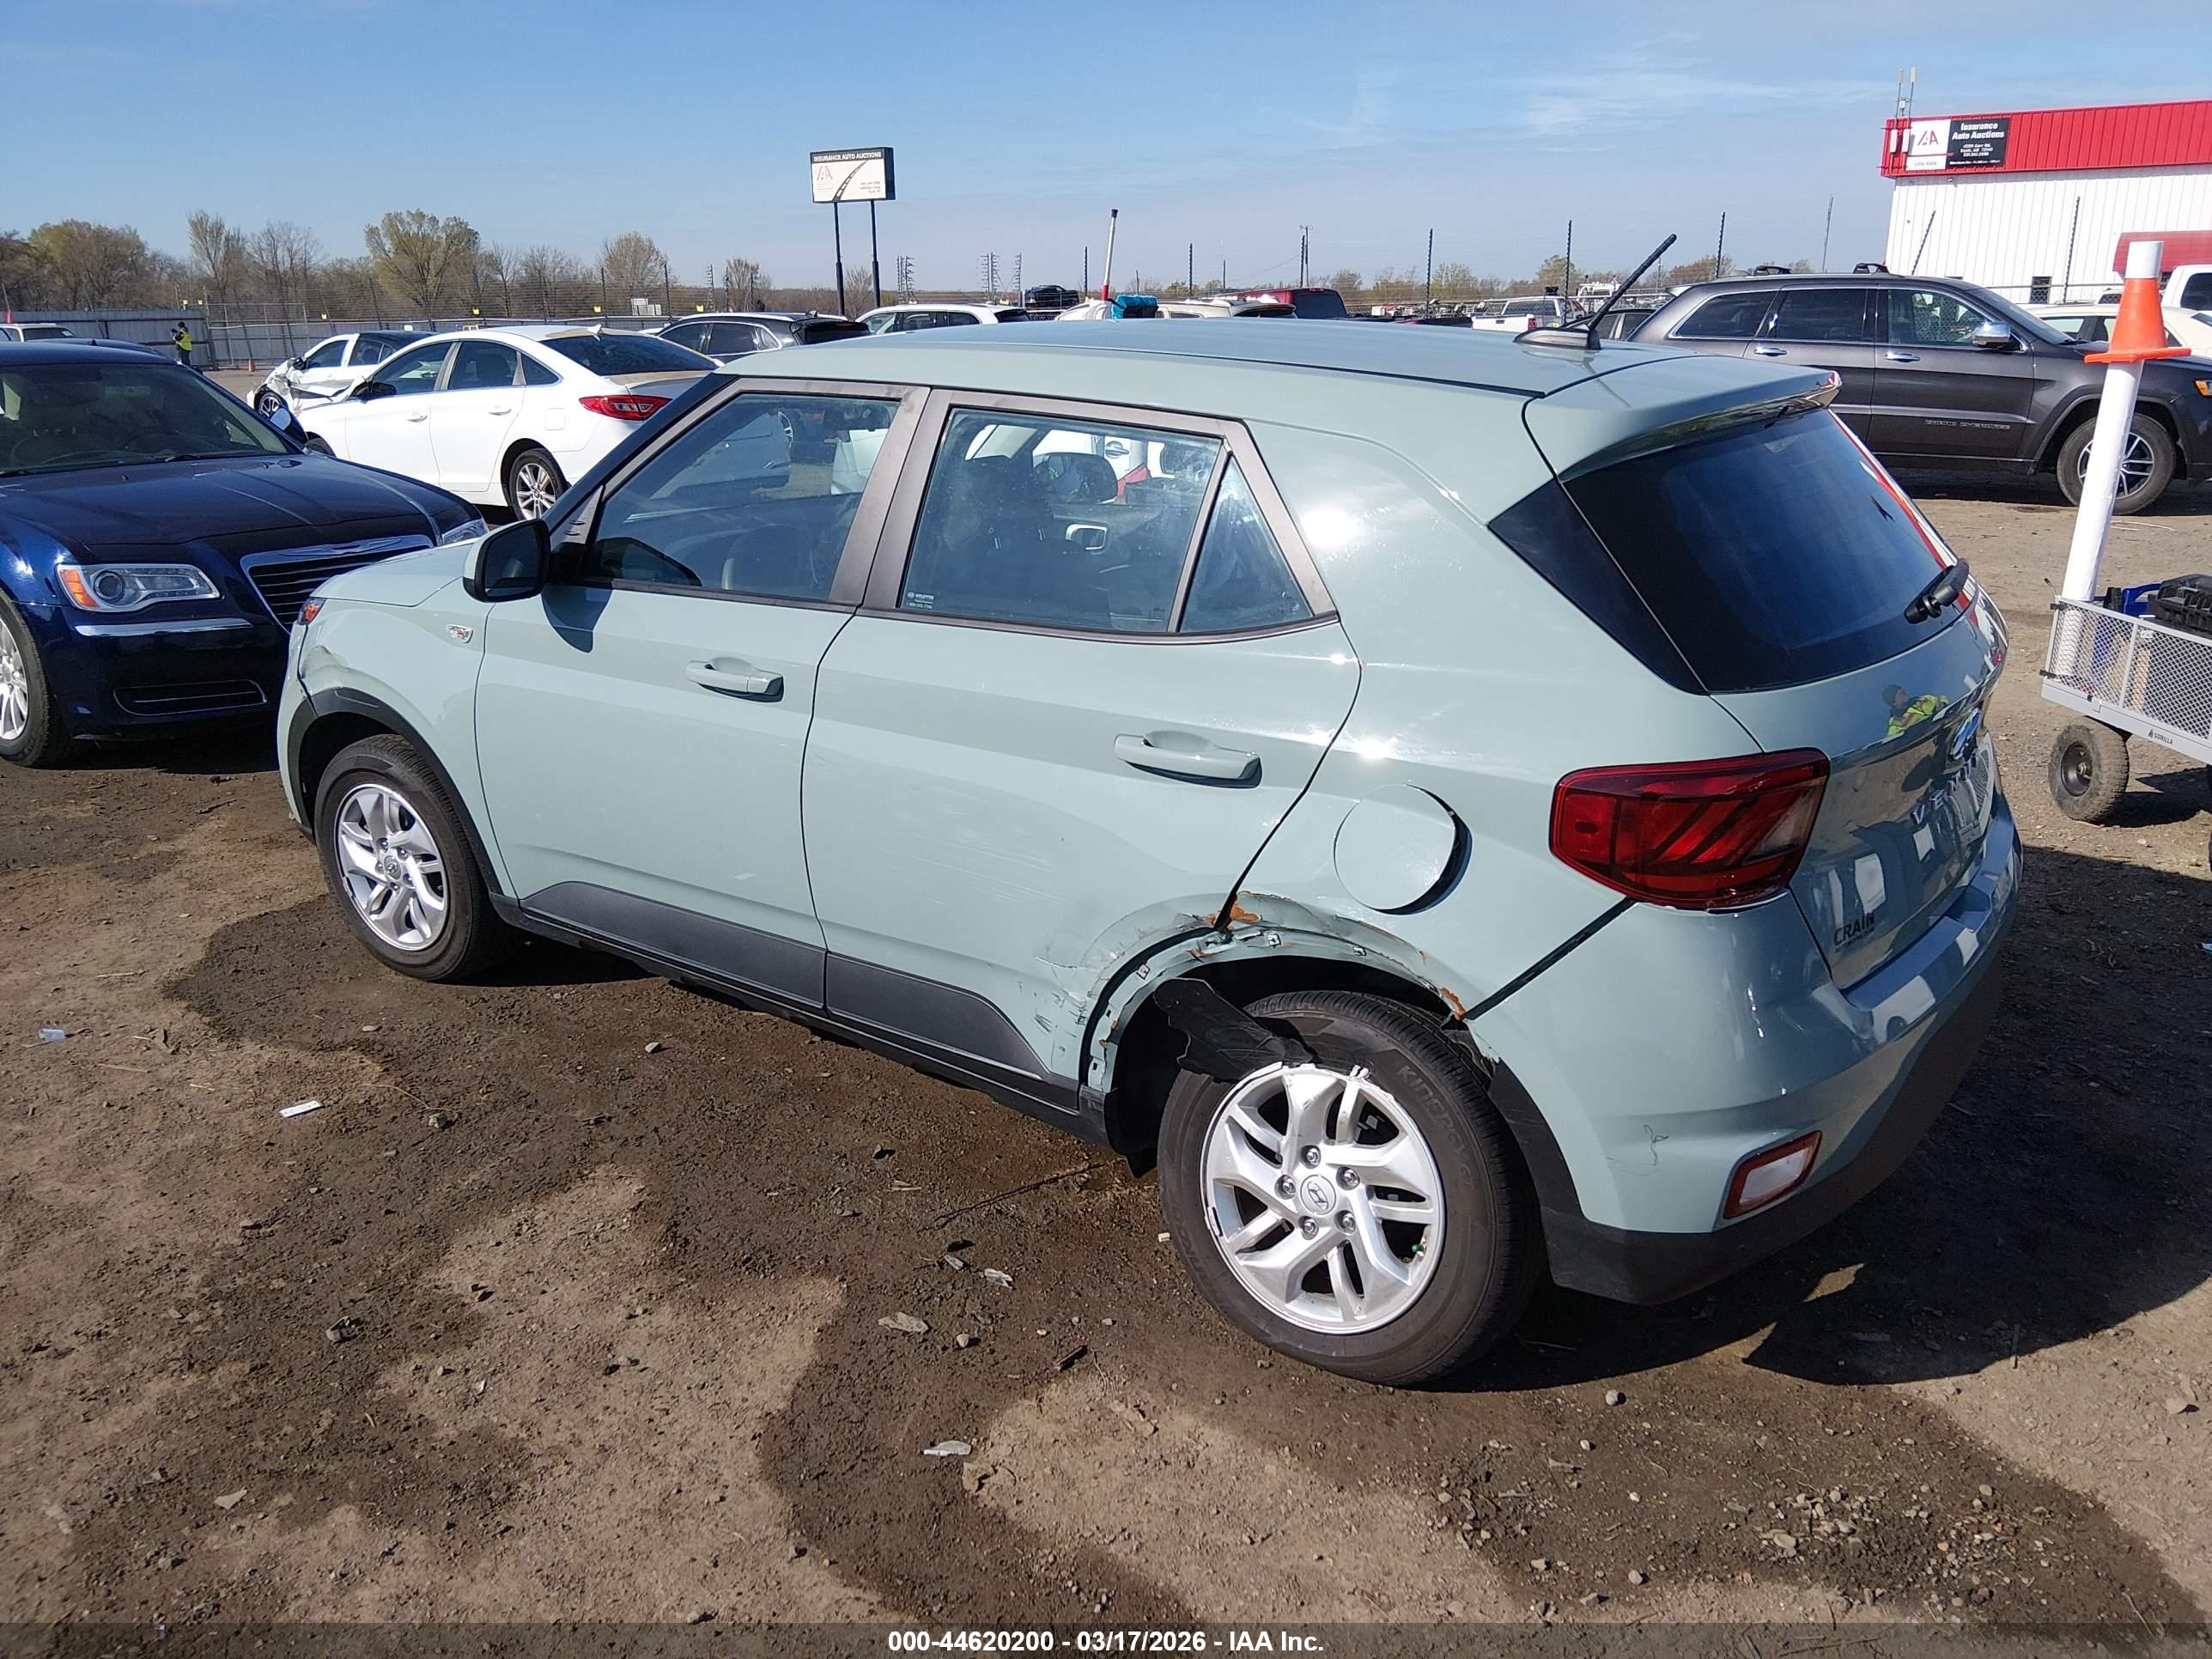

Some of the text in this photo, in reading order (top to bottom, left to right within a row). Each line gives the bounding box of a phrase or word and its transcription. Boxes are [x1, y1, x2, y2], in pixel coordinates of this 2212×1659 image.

[1971, 131, 2005, 139] Auctions
[856, 151, 882, 160] AUCTIONS
[1833, 911, 1875, 946] CRAIN
